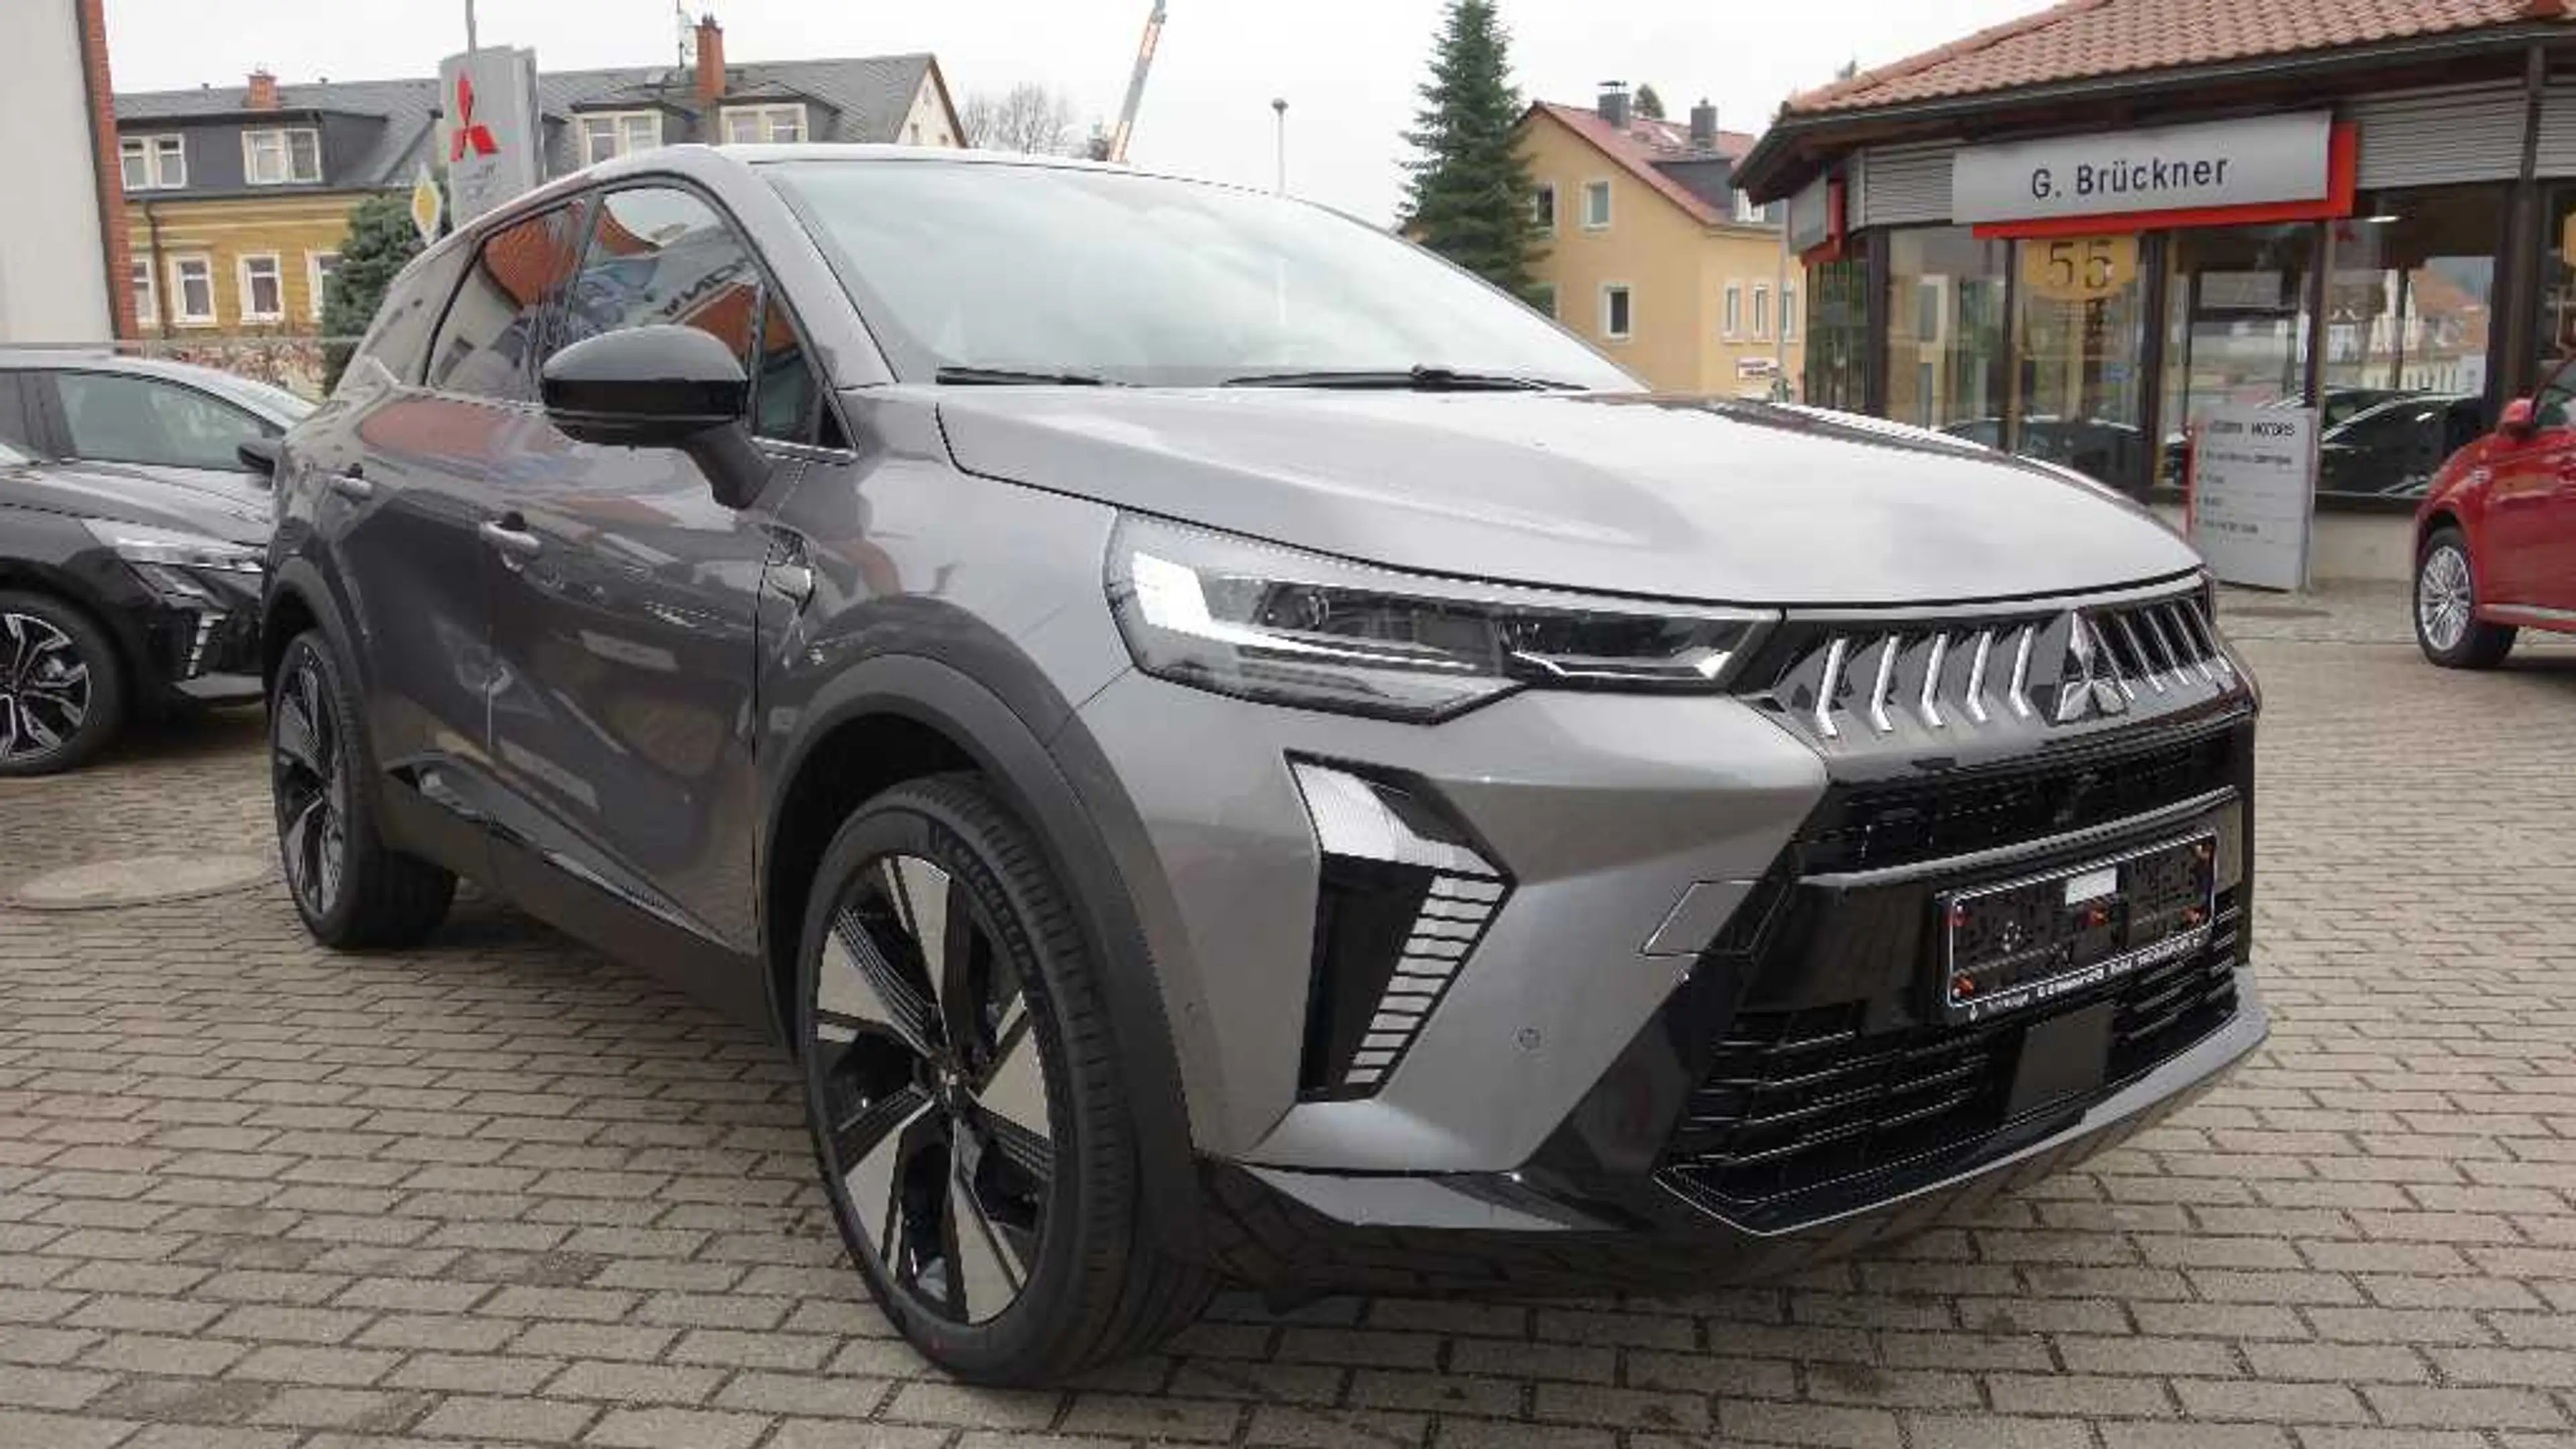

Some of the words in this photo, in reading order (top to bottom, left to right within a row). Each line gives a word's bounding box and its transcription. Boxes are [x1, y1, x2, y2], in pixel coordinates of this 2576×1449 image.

[2031, 168, 2062, 200] G.
[2077, 158, 2228, 196] Brückner
[2047, 239, 2114, 289] 55
